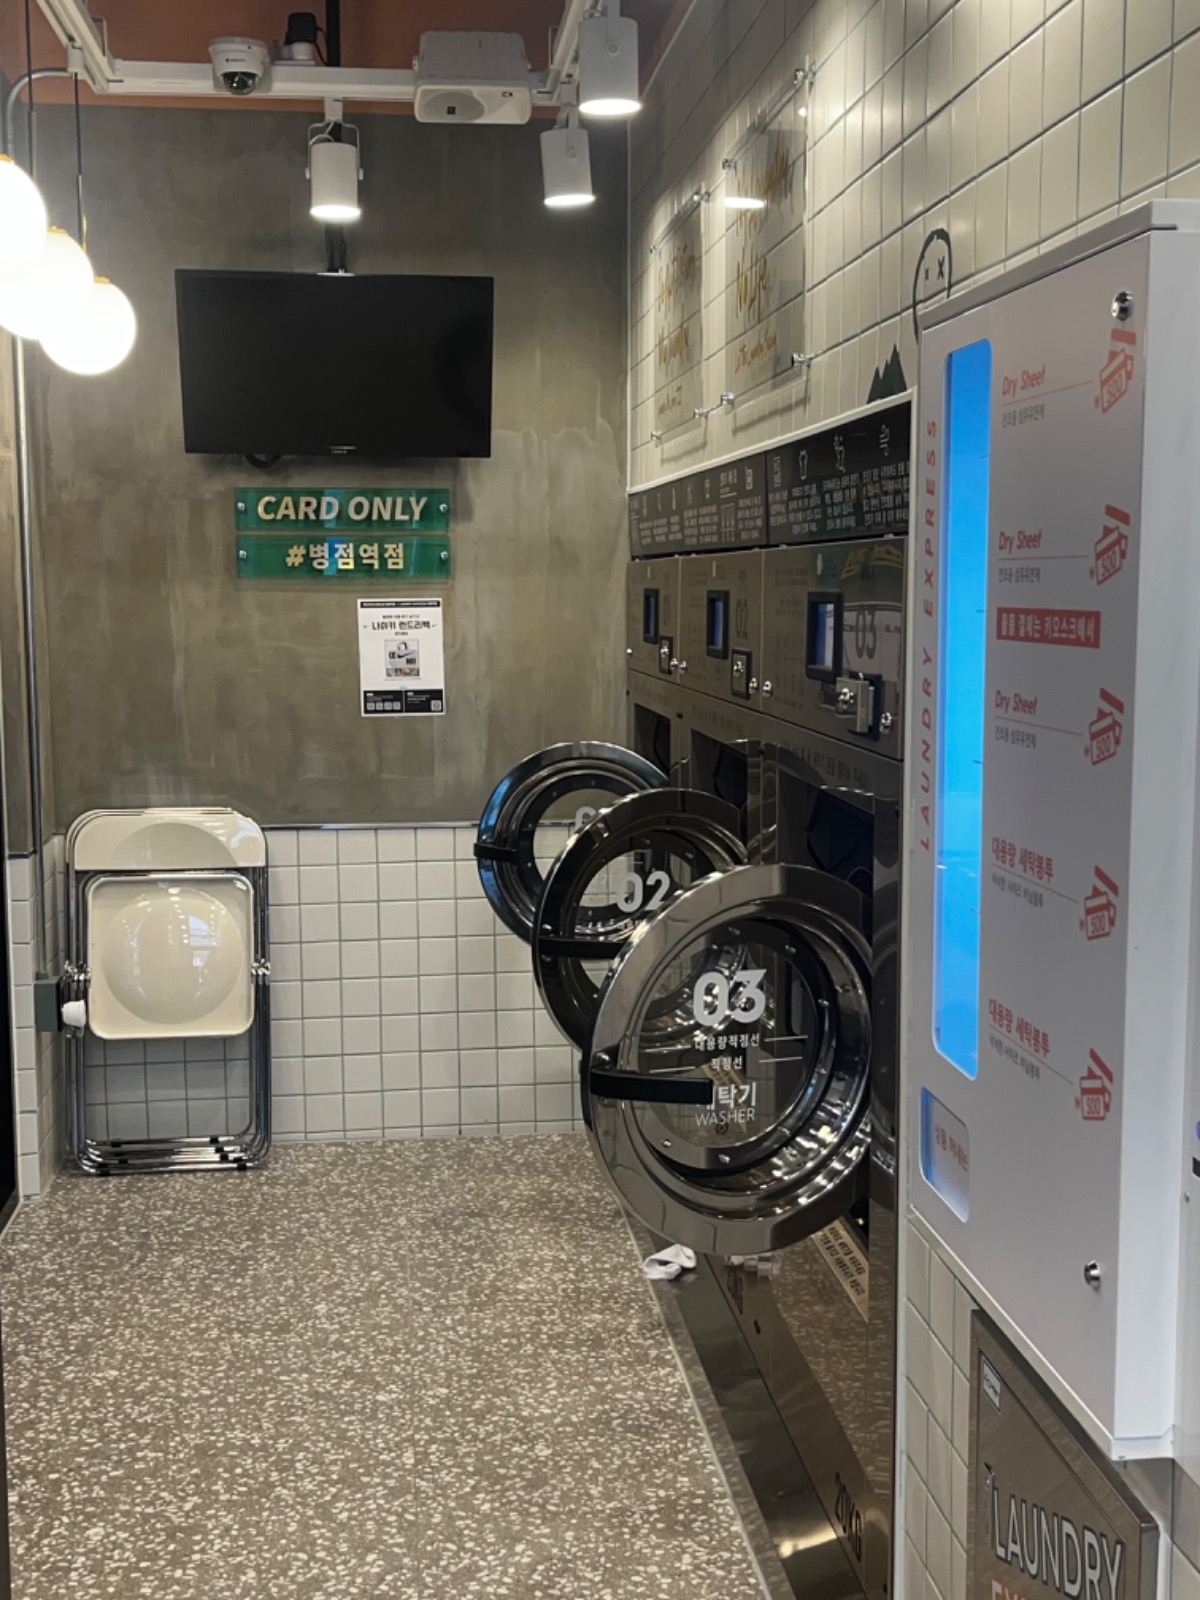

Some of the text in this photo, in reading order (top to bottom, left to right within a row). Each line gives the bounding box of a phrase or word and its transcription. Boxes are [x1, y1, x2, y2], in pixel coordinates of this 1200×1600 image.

[1002, 363, 1046, 398] Dry Sheet
[257, 495, 428, 521] CARD ONLY
[285, 542, 405, 571] #병점역점
[998, 529, 1043, 555] Dry Sheet
[855, 608, 877, 660] 03
[919, 420, 938, 851] LAUNDRY EXPRESS
[995, 690, 1038, 716] Dry Sheet
[991, 836, 1054, 883] 대용량 세탁봉투
[616, 870, 671, 914] 02
[1090, 912, 1106, 935] 500
[693, 969, 768, 1027] 03
[694, 1032, 761, 1052] 대용량적정선
[988, 998, 1050, 1058] 대용량 세탁봉투
[710, 1055, 743, 1072] 적정선
[695, 1107, 756, 1127] WASHER
[1085, 1096, 1101, 1116] 500
[833, 1471, 863, 1563] 20KG
[993, 1485, 1125, 1600] LAUNDRY
